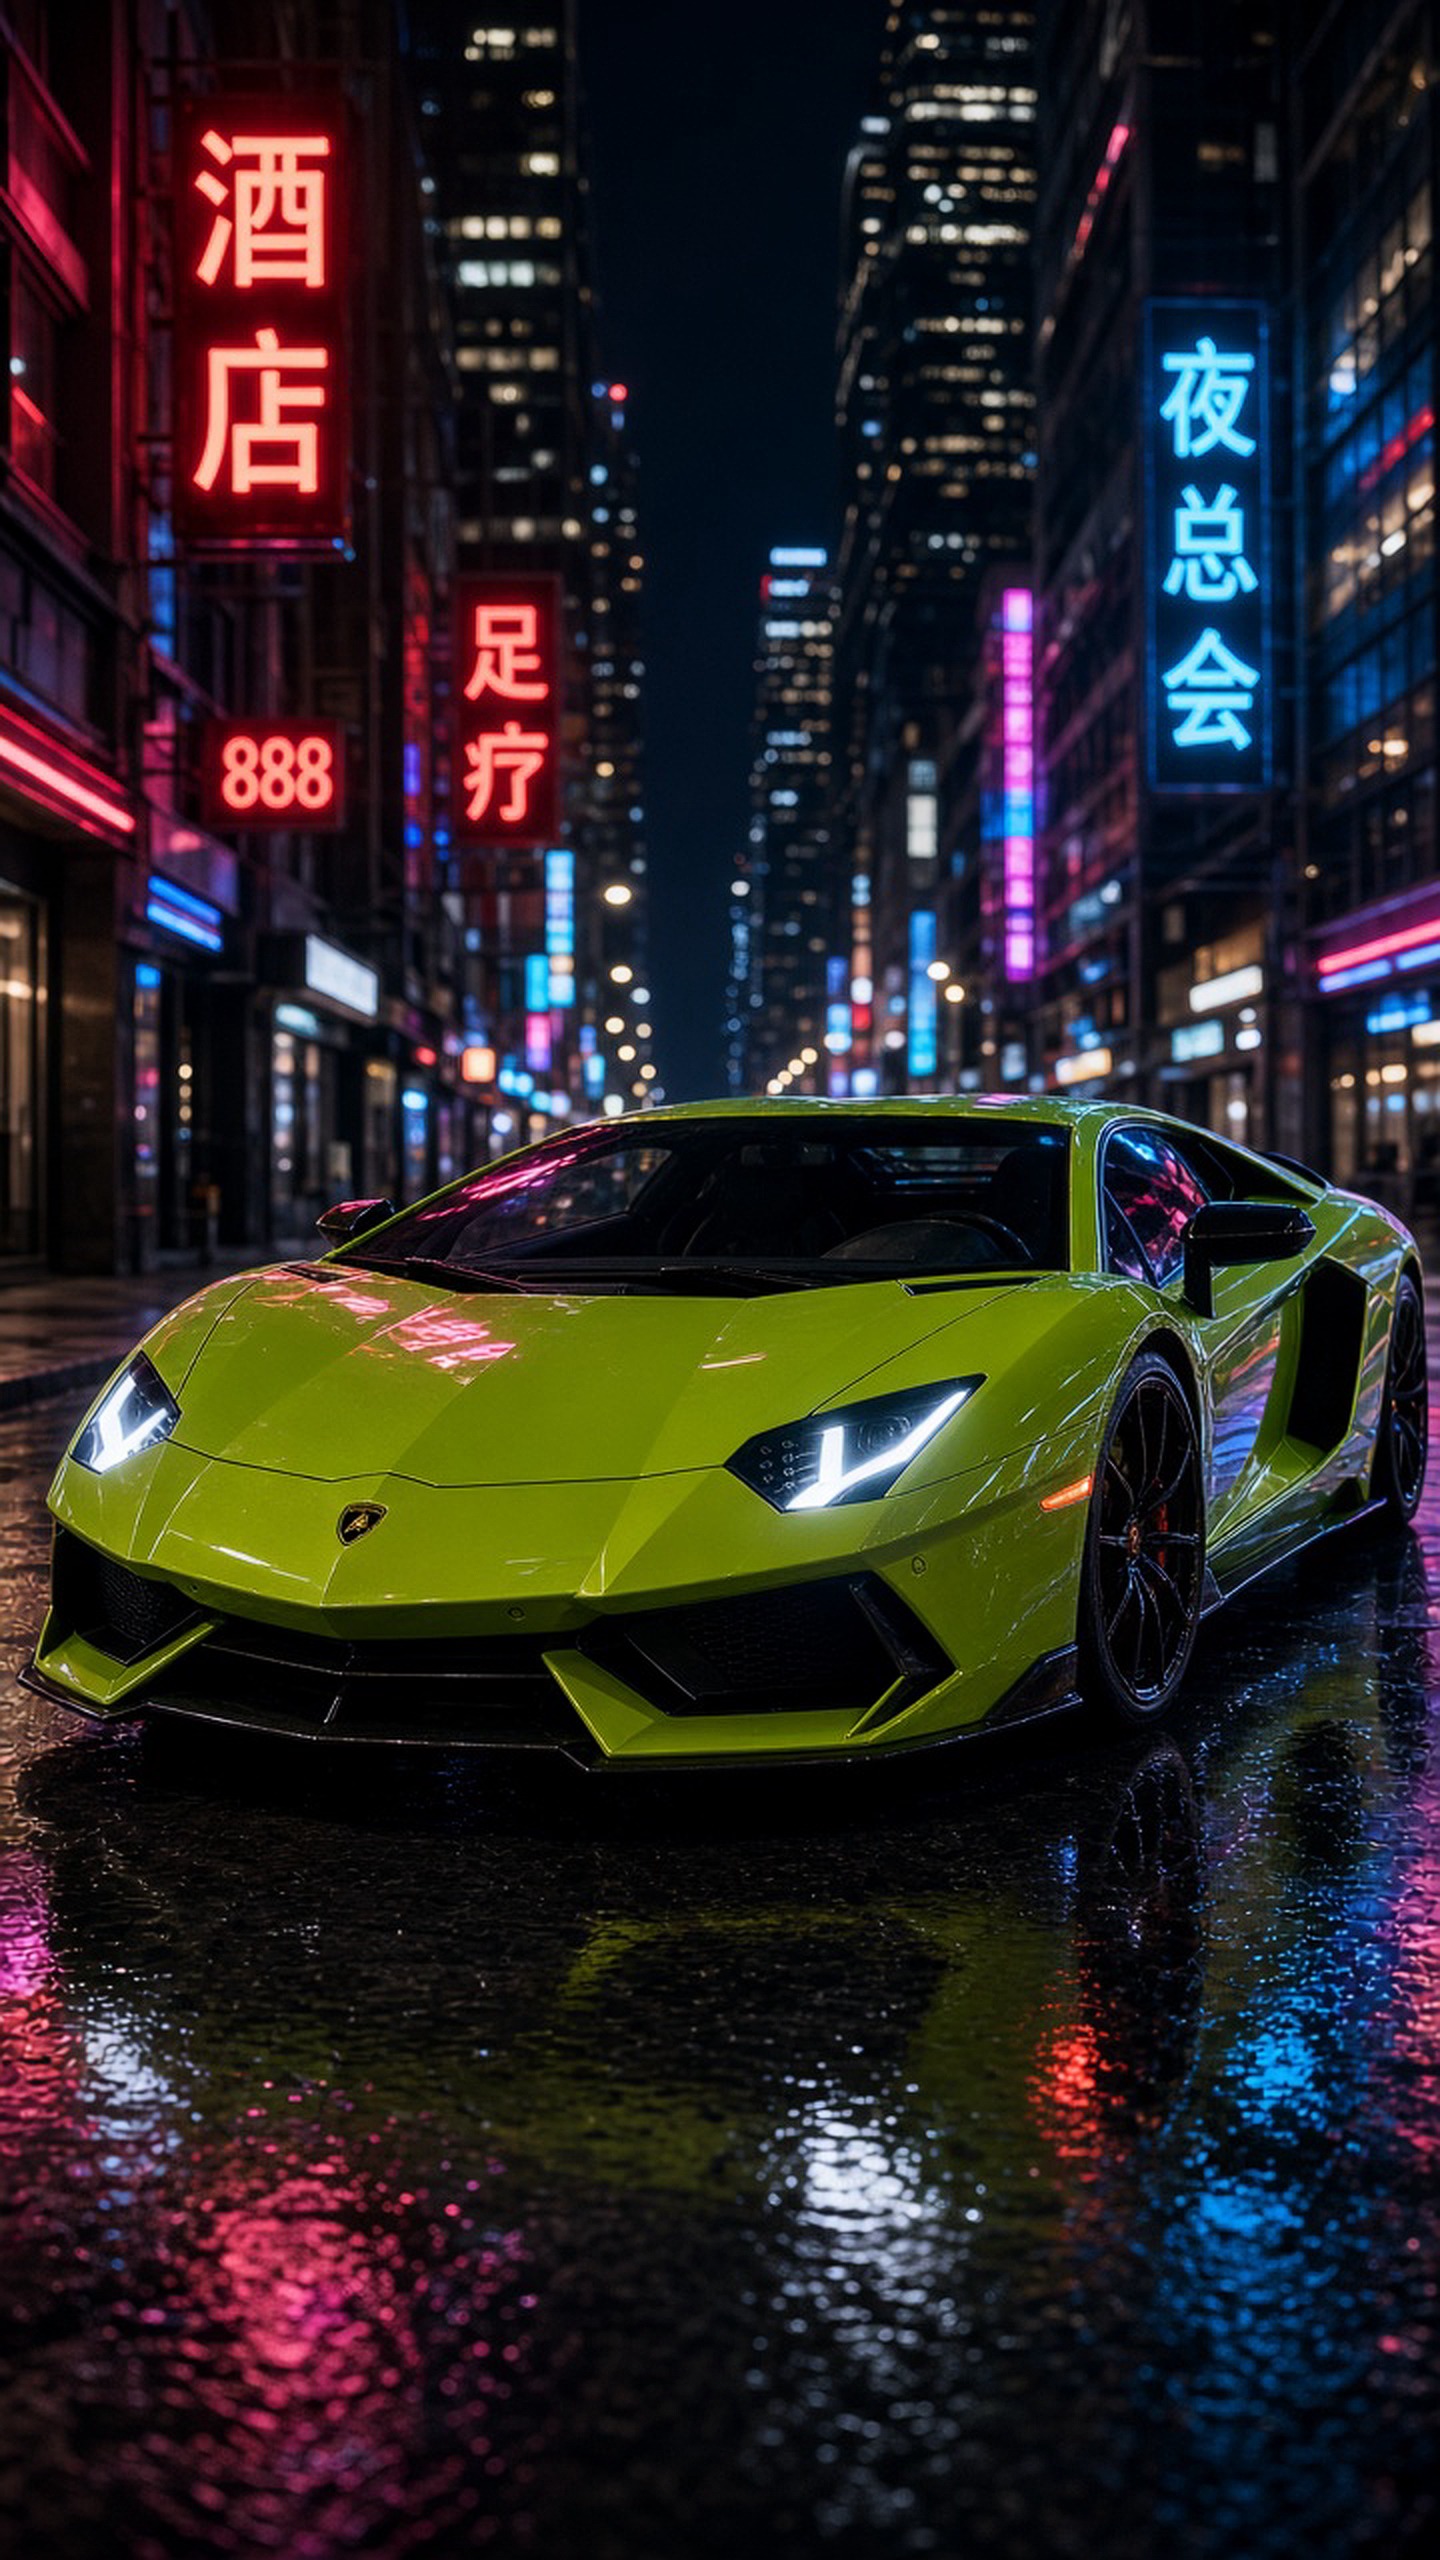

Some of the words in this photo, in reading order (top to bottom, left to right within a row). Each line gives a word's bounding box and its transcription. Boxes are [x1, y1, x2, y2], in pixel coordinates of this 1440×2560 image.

[194, 131, 329, 493] 酒店
[1159, 336, 1261, 751] 夜总会
[222, 736, 333, 809] 888
[464, 605, 548, 822] 足疗
